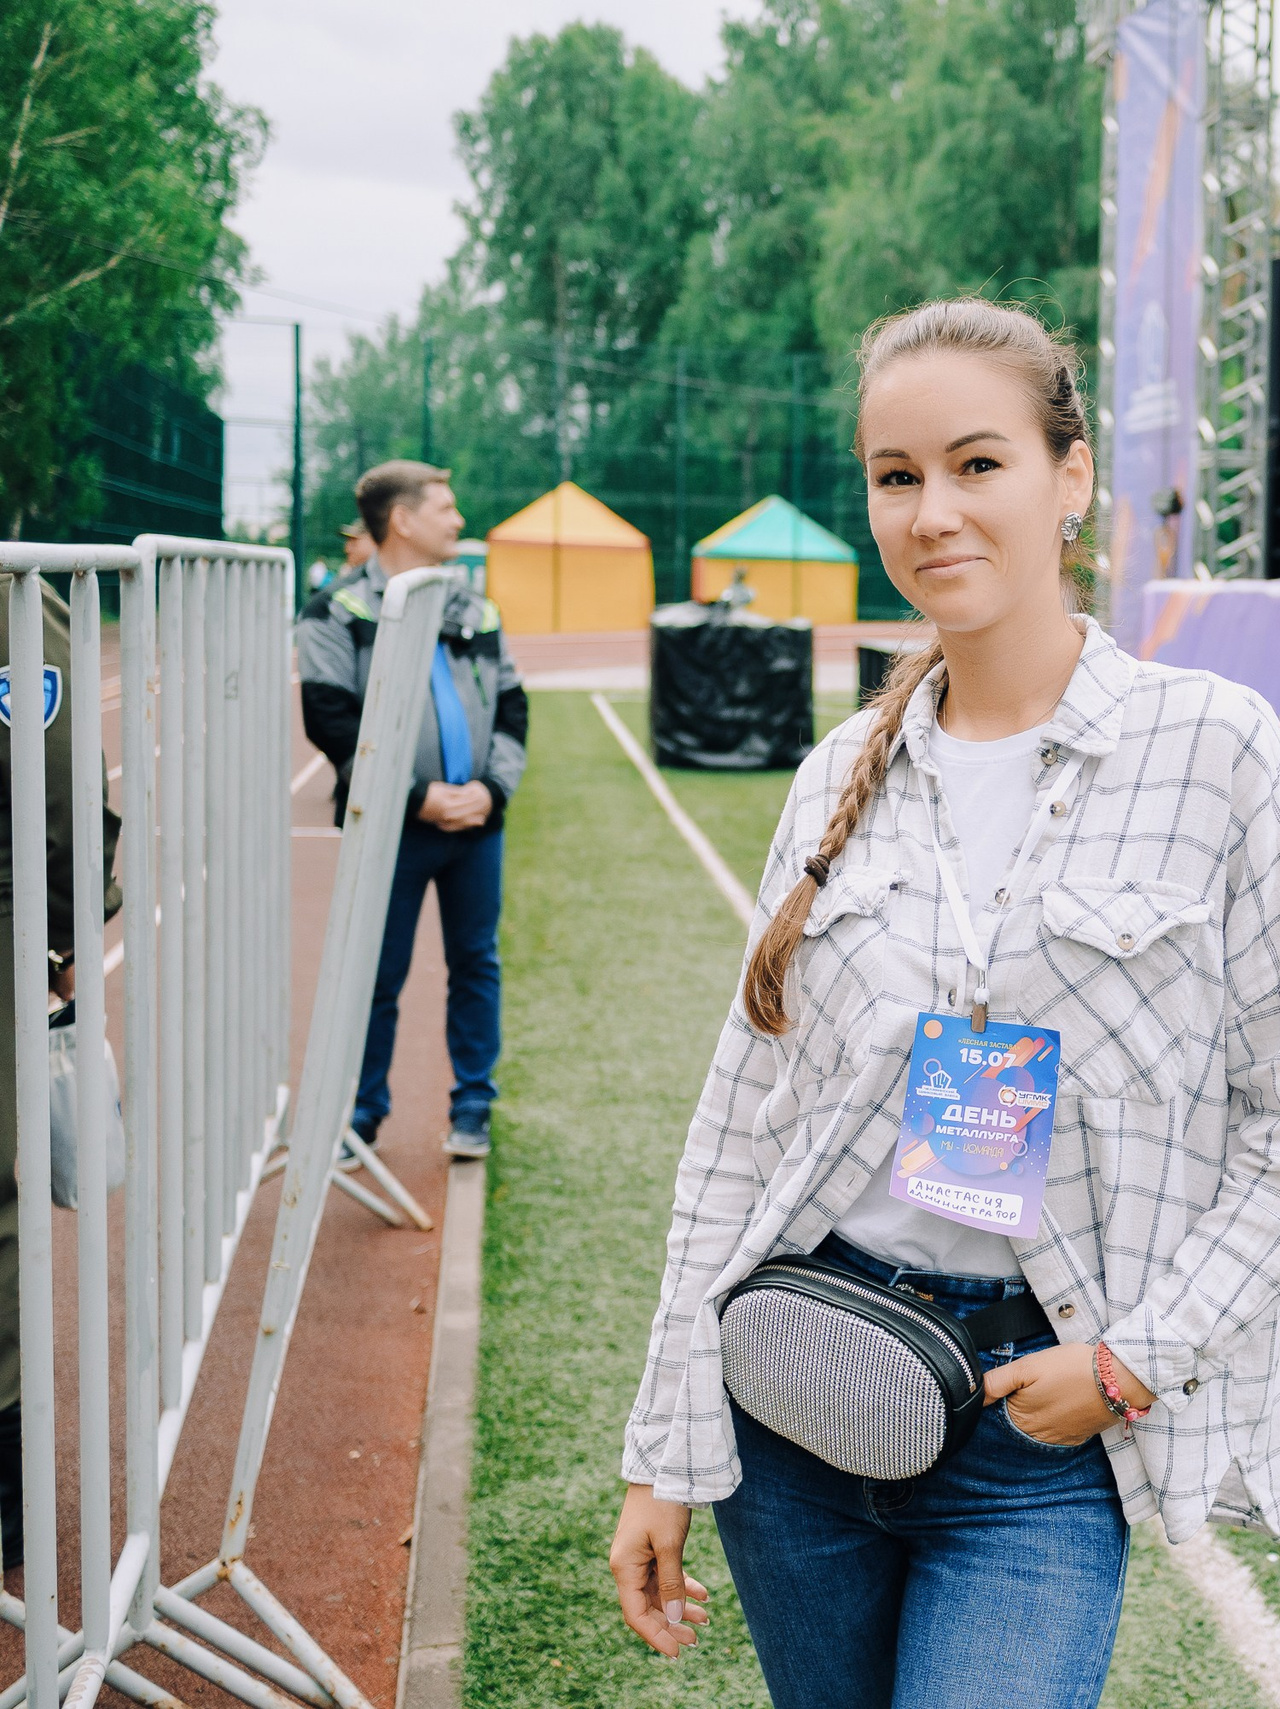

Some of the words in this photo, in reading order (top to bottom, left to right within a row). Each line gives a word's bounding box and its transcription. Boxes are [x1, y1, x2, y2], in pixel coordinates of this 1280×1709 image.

[959, 1048, 1016, 1068] 15.07
[1018, 1092, 1048, 1101] УГМК
[941, 1104, 1017, 1128] ДЕНЬ
[935, 1125, 1019, 1143] МЕТАЛЛУРГА
[915, 1180, 1003, 1209] АНАСТАСИЯ
